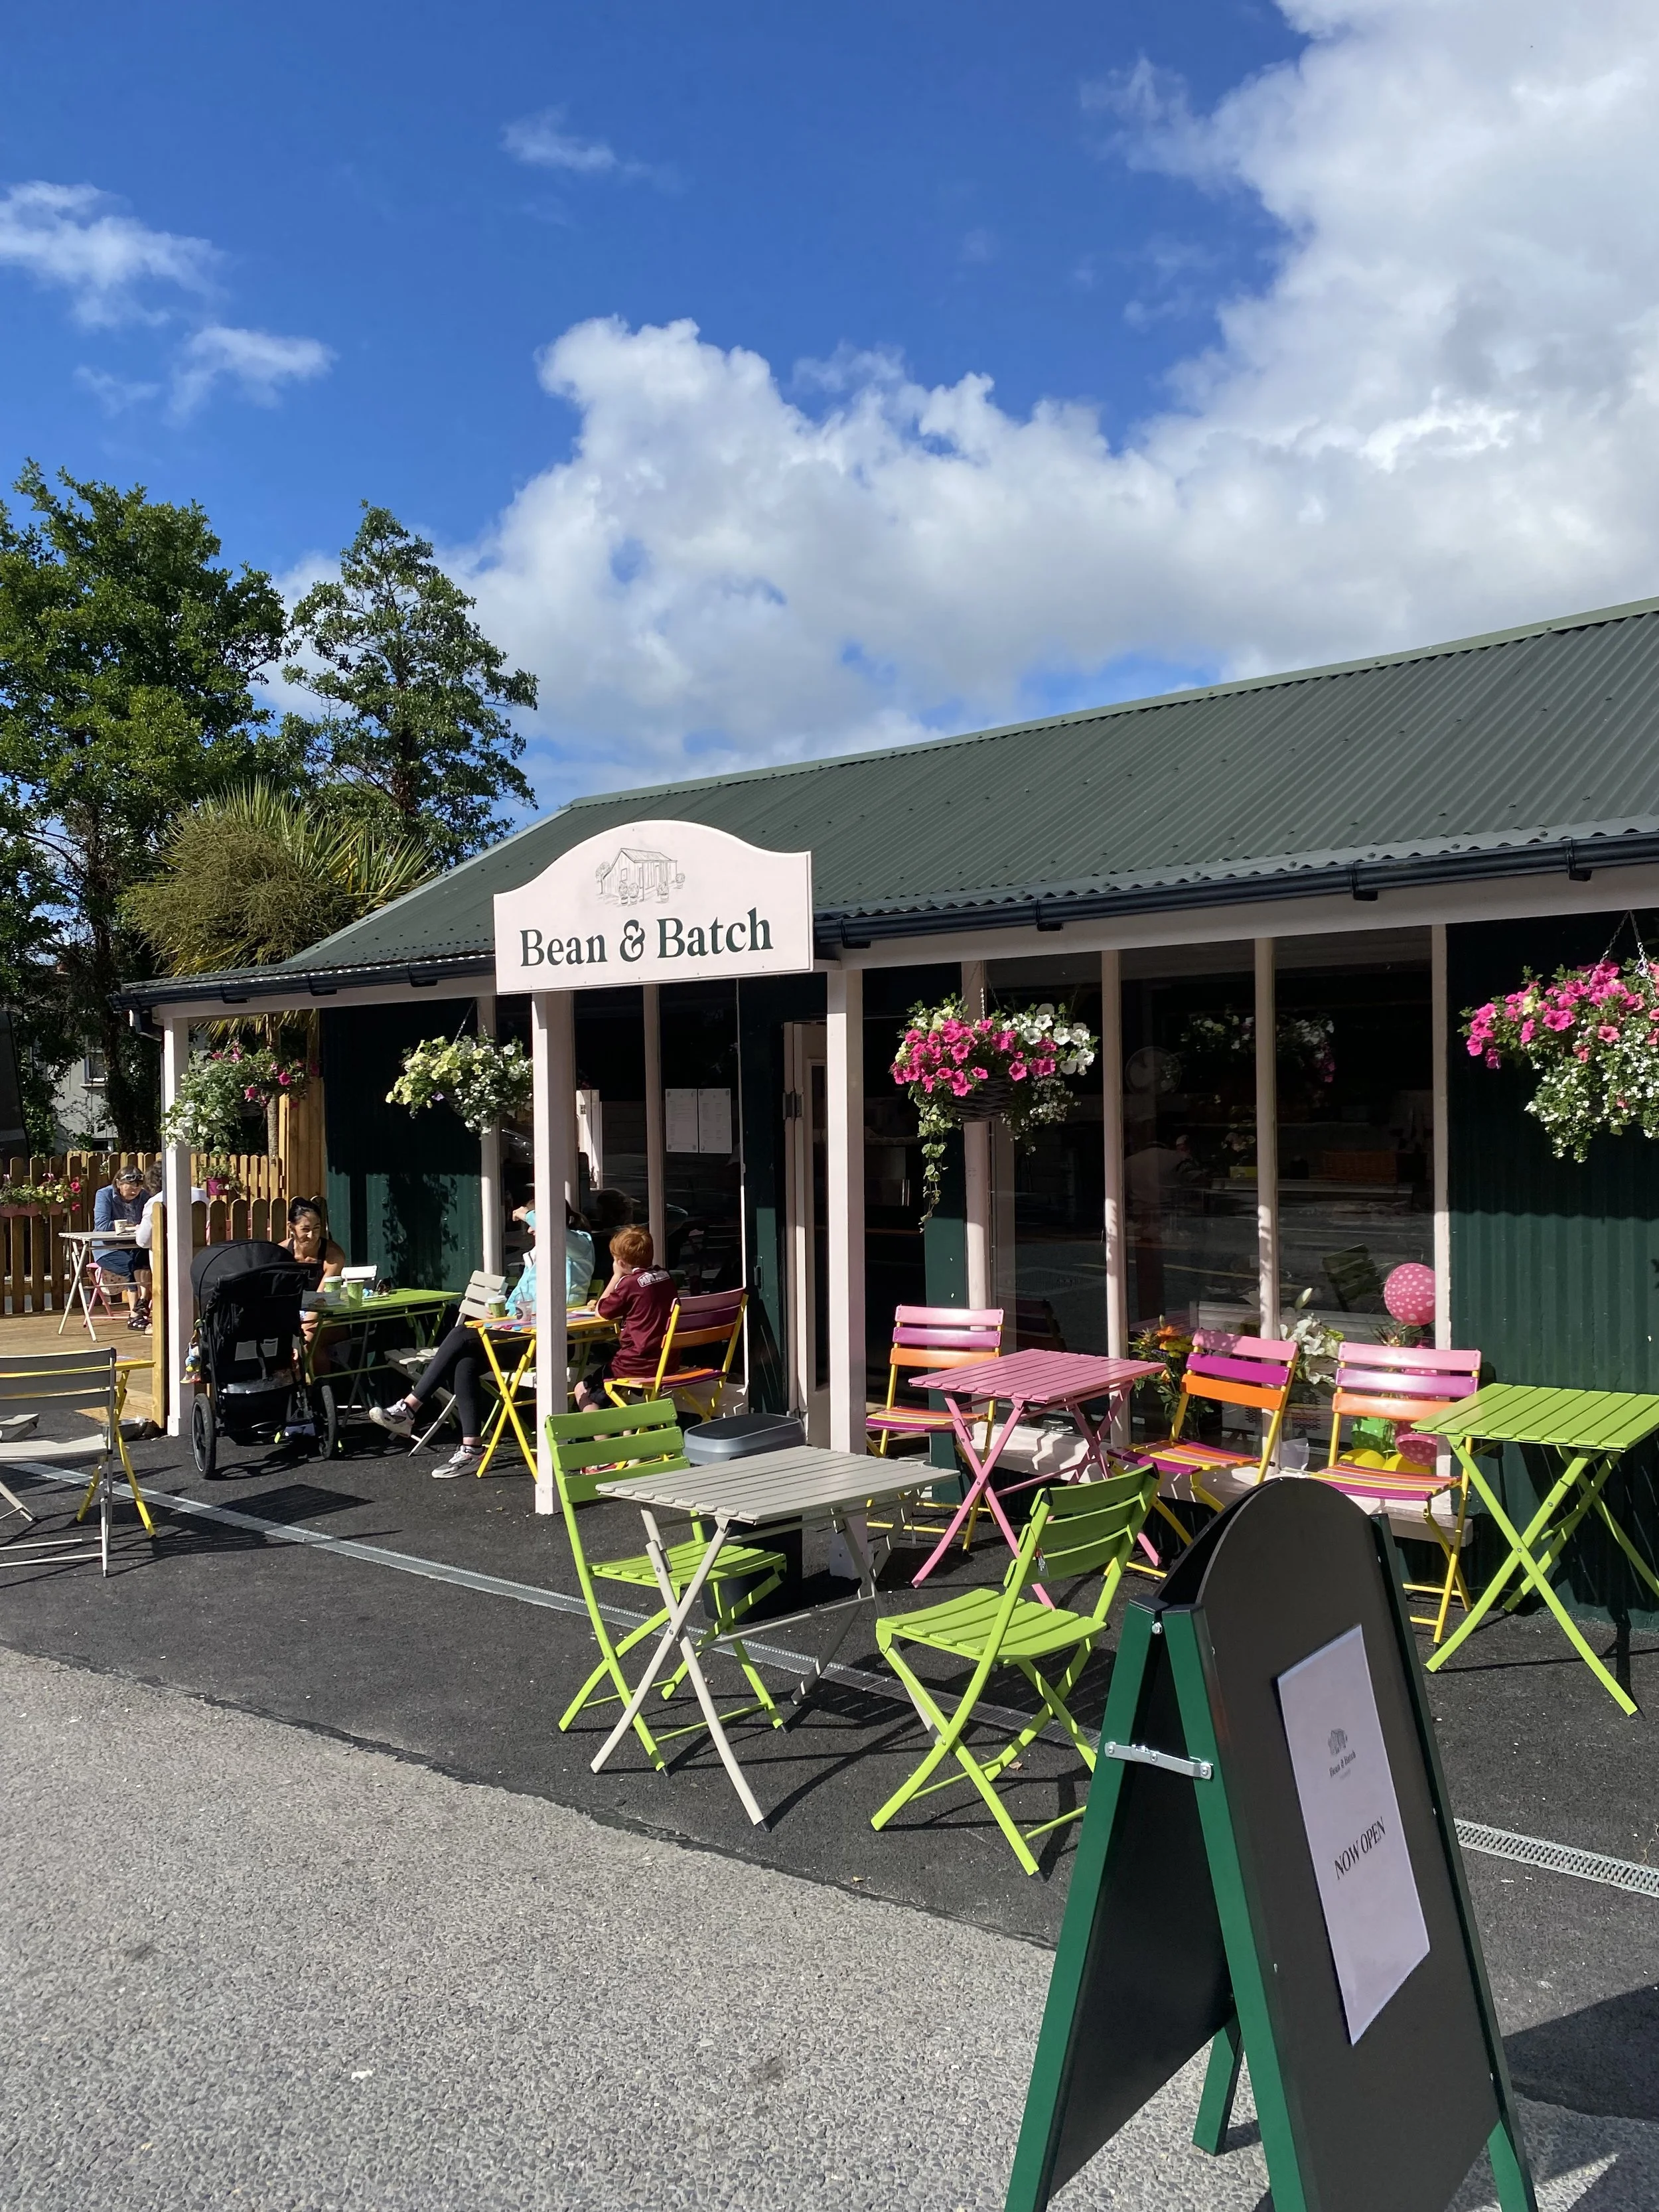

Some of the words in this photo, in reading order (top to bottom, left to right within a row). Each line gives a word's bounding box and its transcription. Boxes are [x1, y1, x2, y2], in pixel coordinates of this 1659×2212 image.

[520, 928, 609, 967] Bean
[619, 919, 646, 963] &
[656, 907, 774, 959] Batch
[1334, 1840, 1360, 1880] NOW
[1360, 1816, 1386, 1854] OPEN
